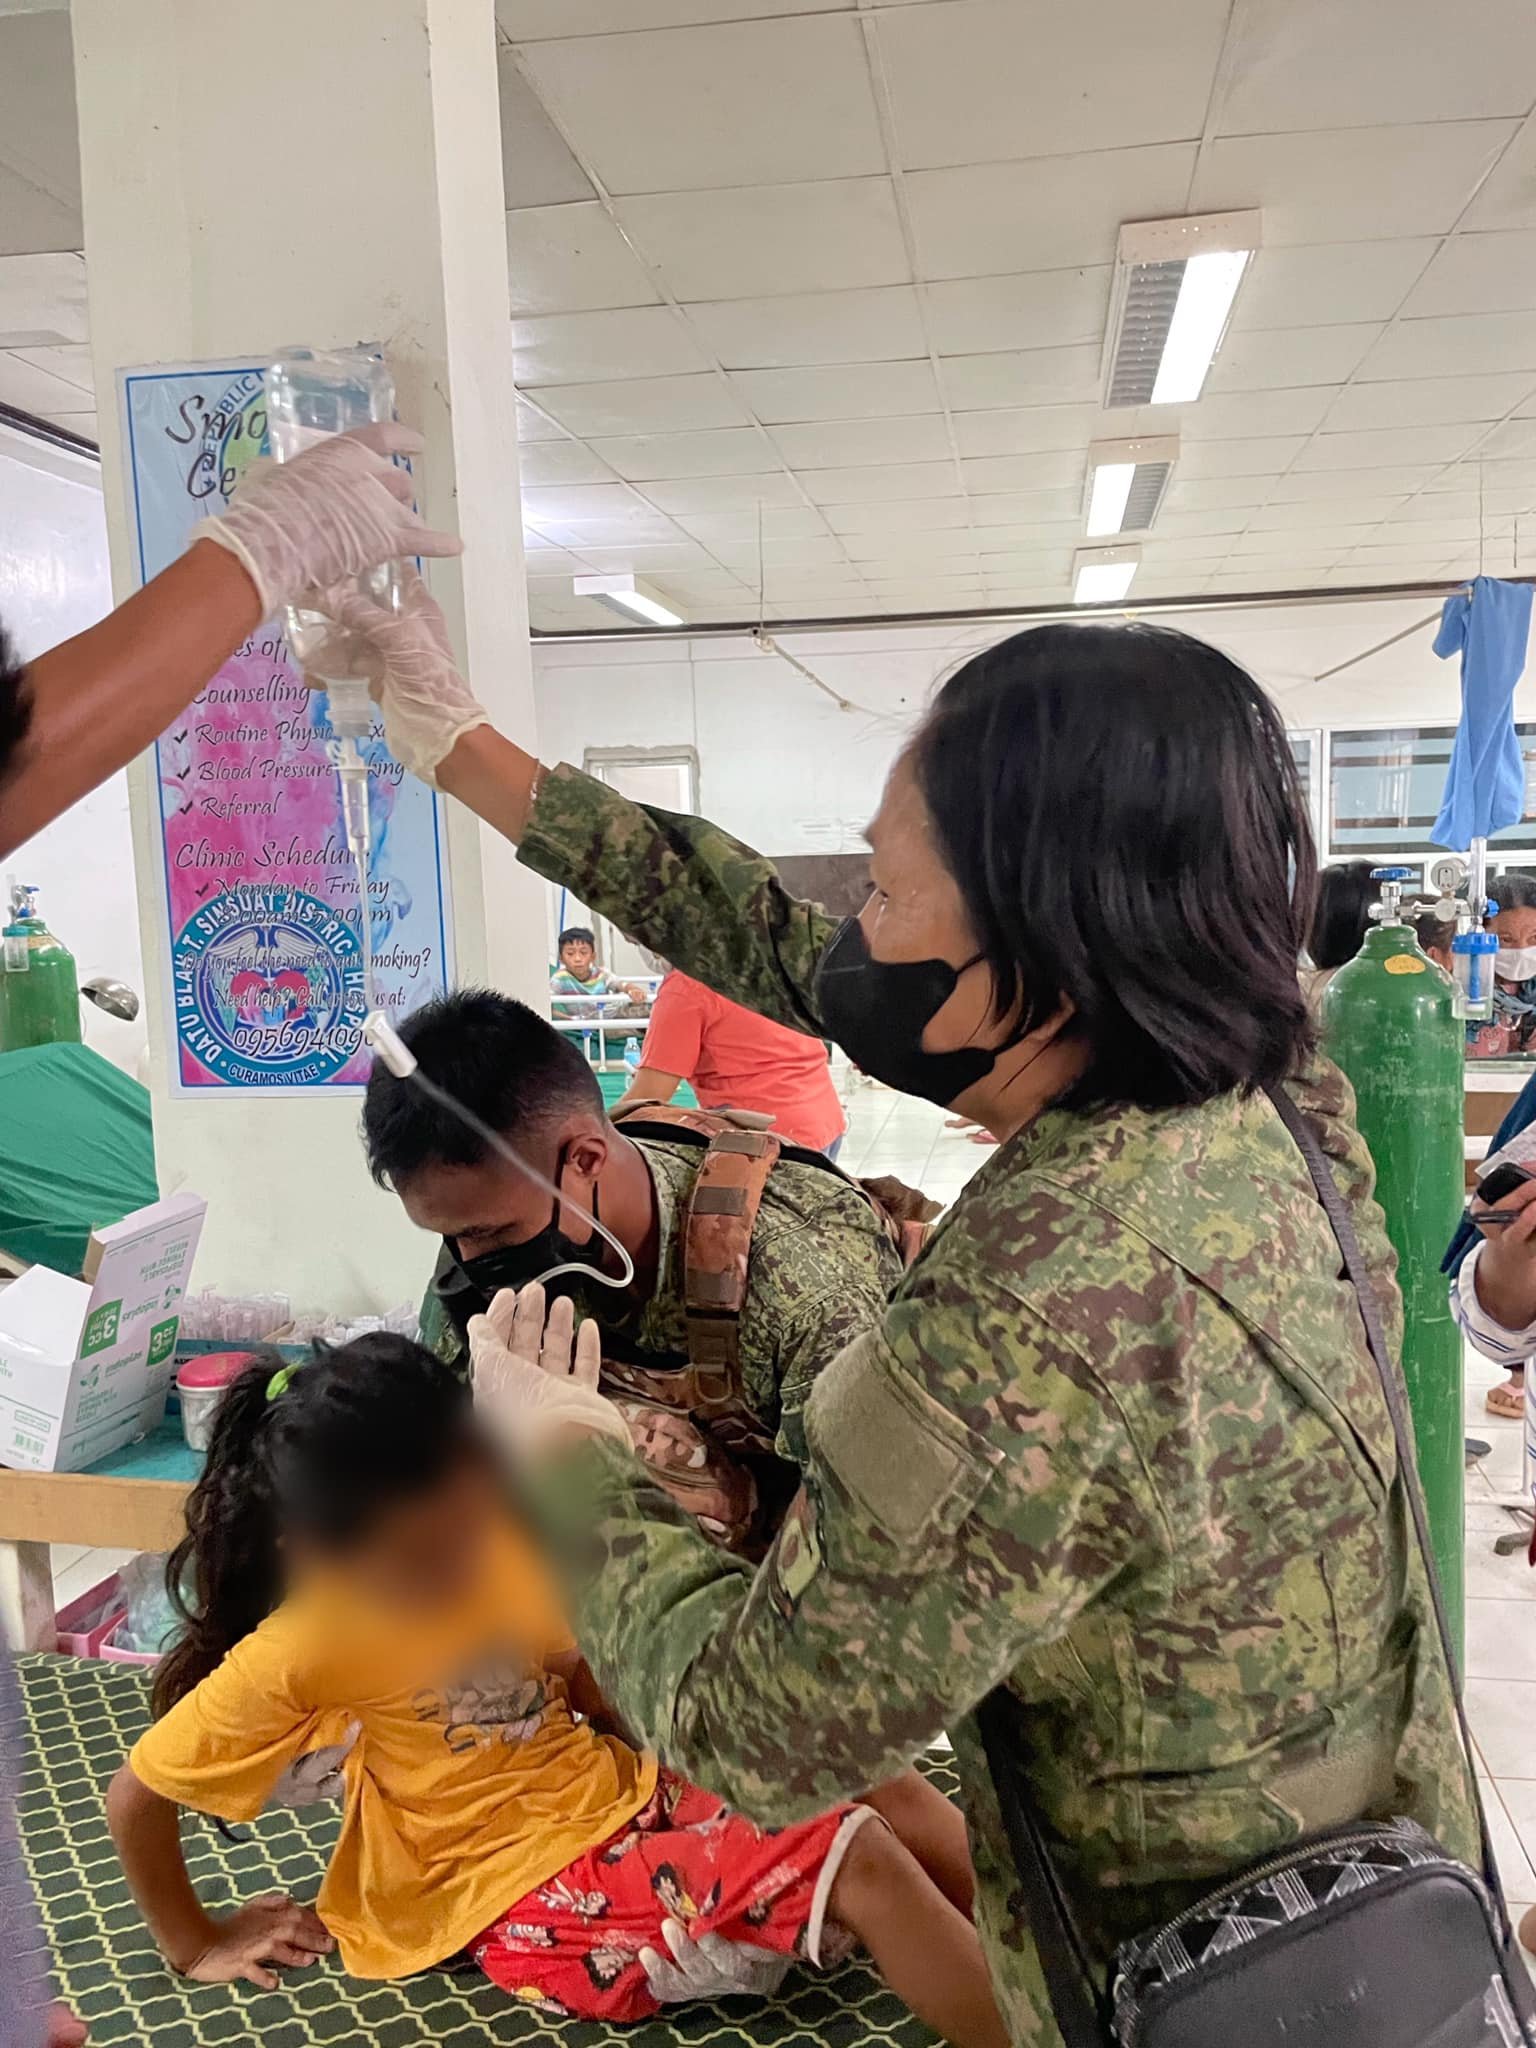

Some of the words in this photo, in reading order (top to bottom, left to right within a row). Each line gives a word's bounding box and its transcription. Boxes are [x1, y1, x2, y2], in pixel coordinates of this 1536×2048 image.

[164, 394, 268, 444] Smo
[195, 723, 268, 745] Routine
[198, 756, 257, 780] Blood
[259, 759, 334, 781] Pressure
[367, 752, 404, 786] king
[201, 791, 282, 822] Referral
[176, 838, 245, 868] Clinic
[215, 874, 296, 908] Monday
[303, 878, 318, 895] to
[325, 872, 389, 904] Friday
[179, 1013, 223, 1064] DATU
[283, 891, 358, 961] DISTRIC
[284, 946, 318, 969] need
[371, 944, 431, 979] moking?
[214, 984, 252, 1008] Need
[254, 982, 291, 1017] help?
[297, 982, 325, 1008] Call
[388, 986, 406, 1006] at:
[229, 1064, 286, 1085] CURAMOS
[285, 1064, 318, 1084] VITAE
